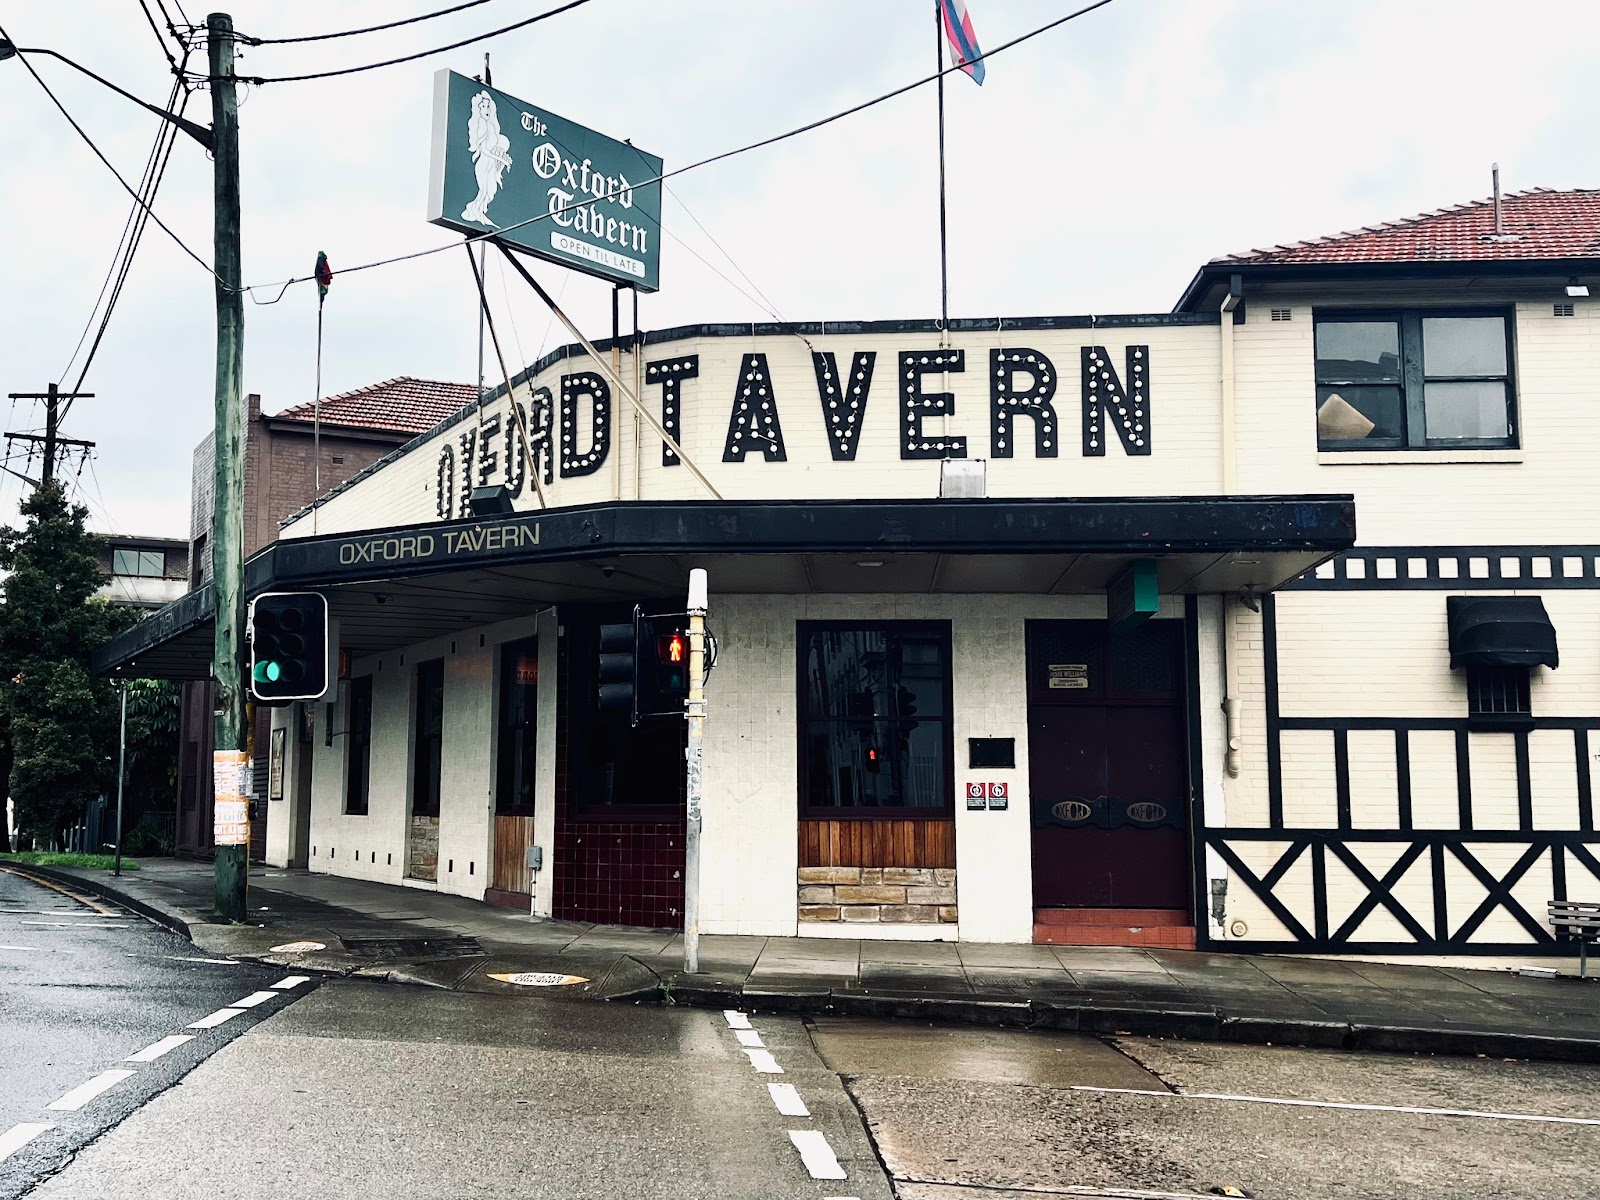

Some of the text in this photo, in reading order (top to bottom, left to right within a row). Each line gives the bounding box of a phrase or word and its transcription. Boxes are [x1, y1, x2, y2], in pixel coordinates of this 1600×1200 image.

[520, 111, 547, 137] The
[532, 142, 634, 209] Oxford
[547, 187, 648, 254] Tavern
[560, 237, 637, 272] OPEN TIL LATE
[646, 345, 1151, 466] TAVERN
[339, 523, 540, 565] OXFORD TAVERN
[1055, 803, 1088, 819] OXFORD
[1130, 804, 1164, 821] OXFORD
